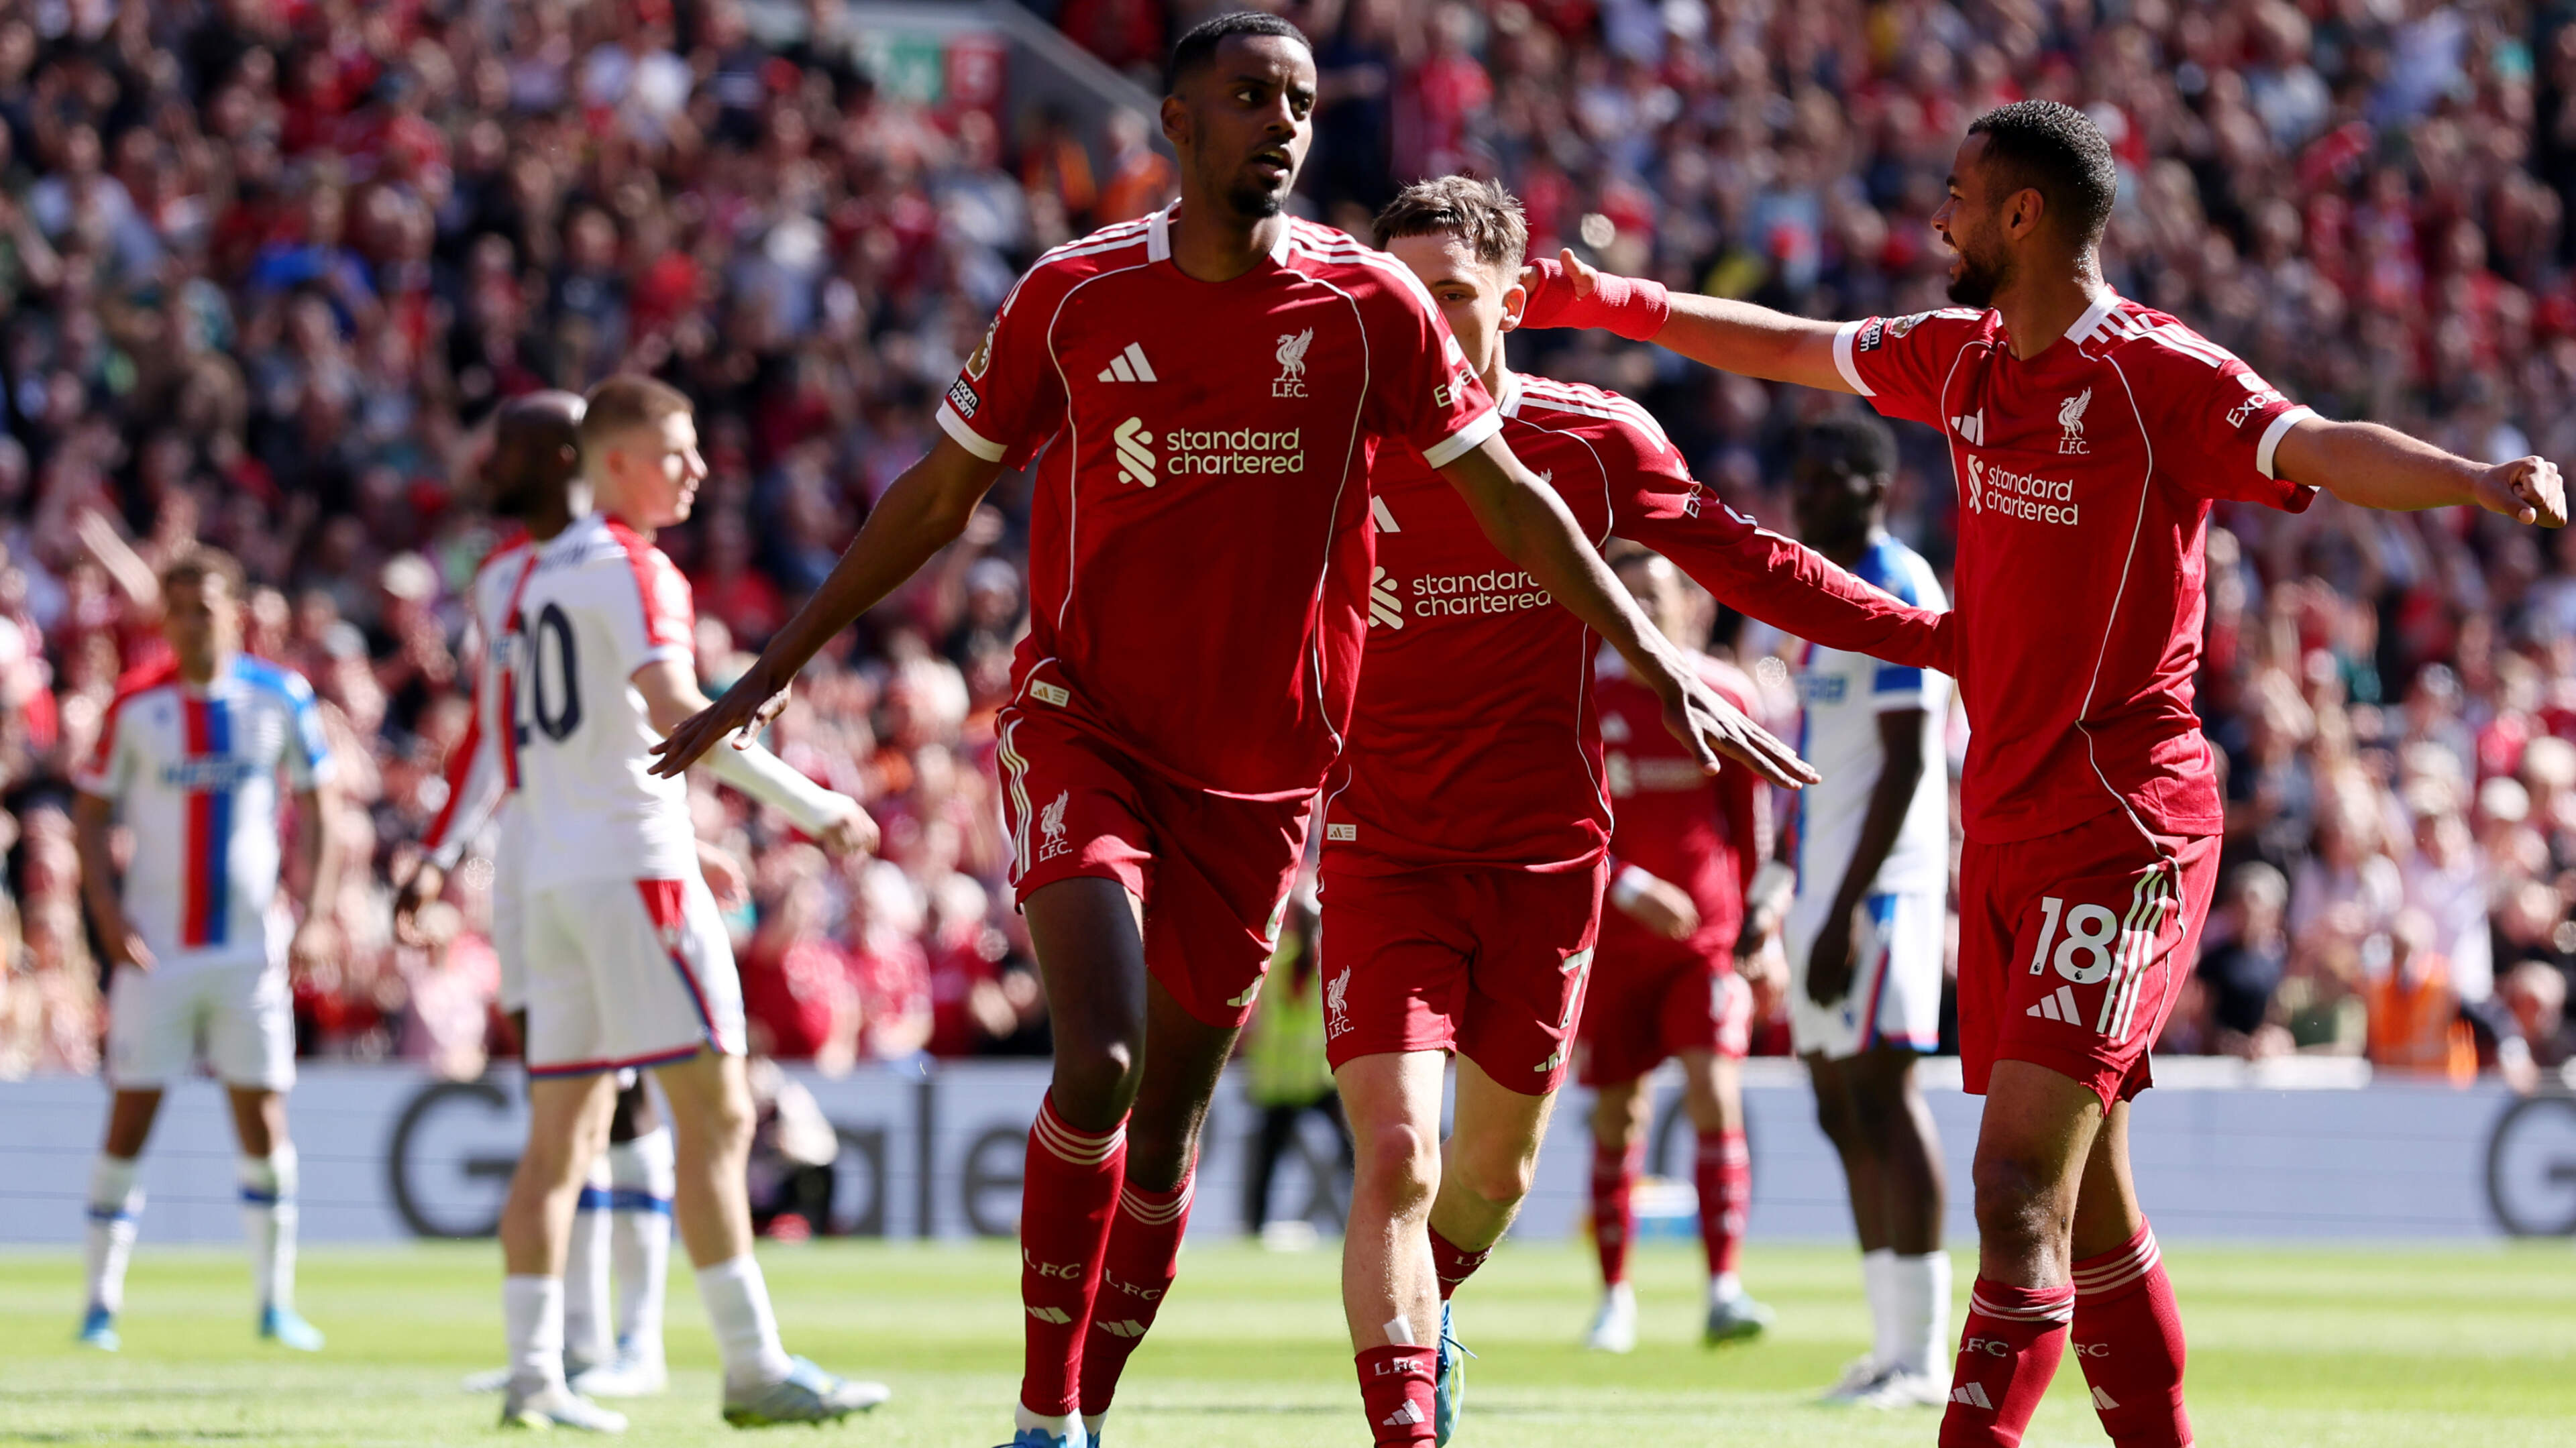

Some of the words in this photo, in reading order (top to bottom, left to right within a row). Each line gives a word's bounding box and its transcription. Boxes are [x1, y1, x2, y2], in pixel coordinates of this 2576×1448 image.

[956, 379, 977, 407] room
[1272, 382, 1309, 397] L.F.C.
[1167, 427, 1300, 451] standard
[2058, 441, 2090, 455] L.F.C.
[1167, 449, 1304, 475] chartered
[1988, 464, 2073, 502] standard
[1986, 488, 2078, 525] chartered
[2029, 896, 2117, 984] 18
[1563, 945, 1593, 1029] 7
[1024, 1247, 1081, 1280] LFC
[1106, 1267, 1161, 1300] LFC
[1375, 1357, 1424, 1376] LFC
